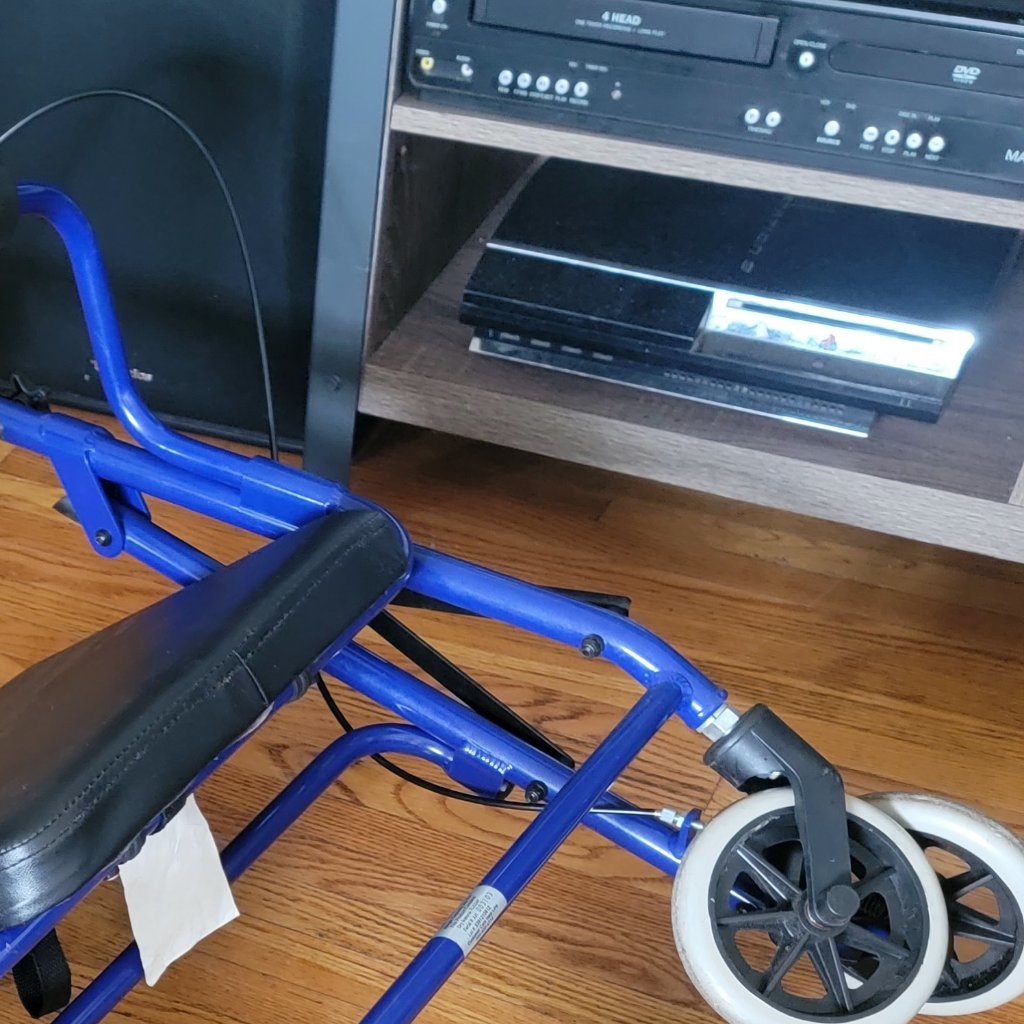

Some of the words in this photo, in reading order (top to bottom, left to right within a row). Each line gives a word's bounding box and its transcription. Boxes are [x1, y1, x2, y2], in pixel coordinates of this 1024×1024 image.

[601, 10, 610, 22] 4
[611, 12, 642, 26] HEAD
[953, 64, 981, 77] DVD
